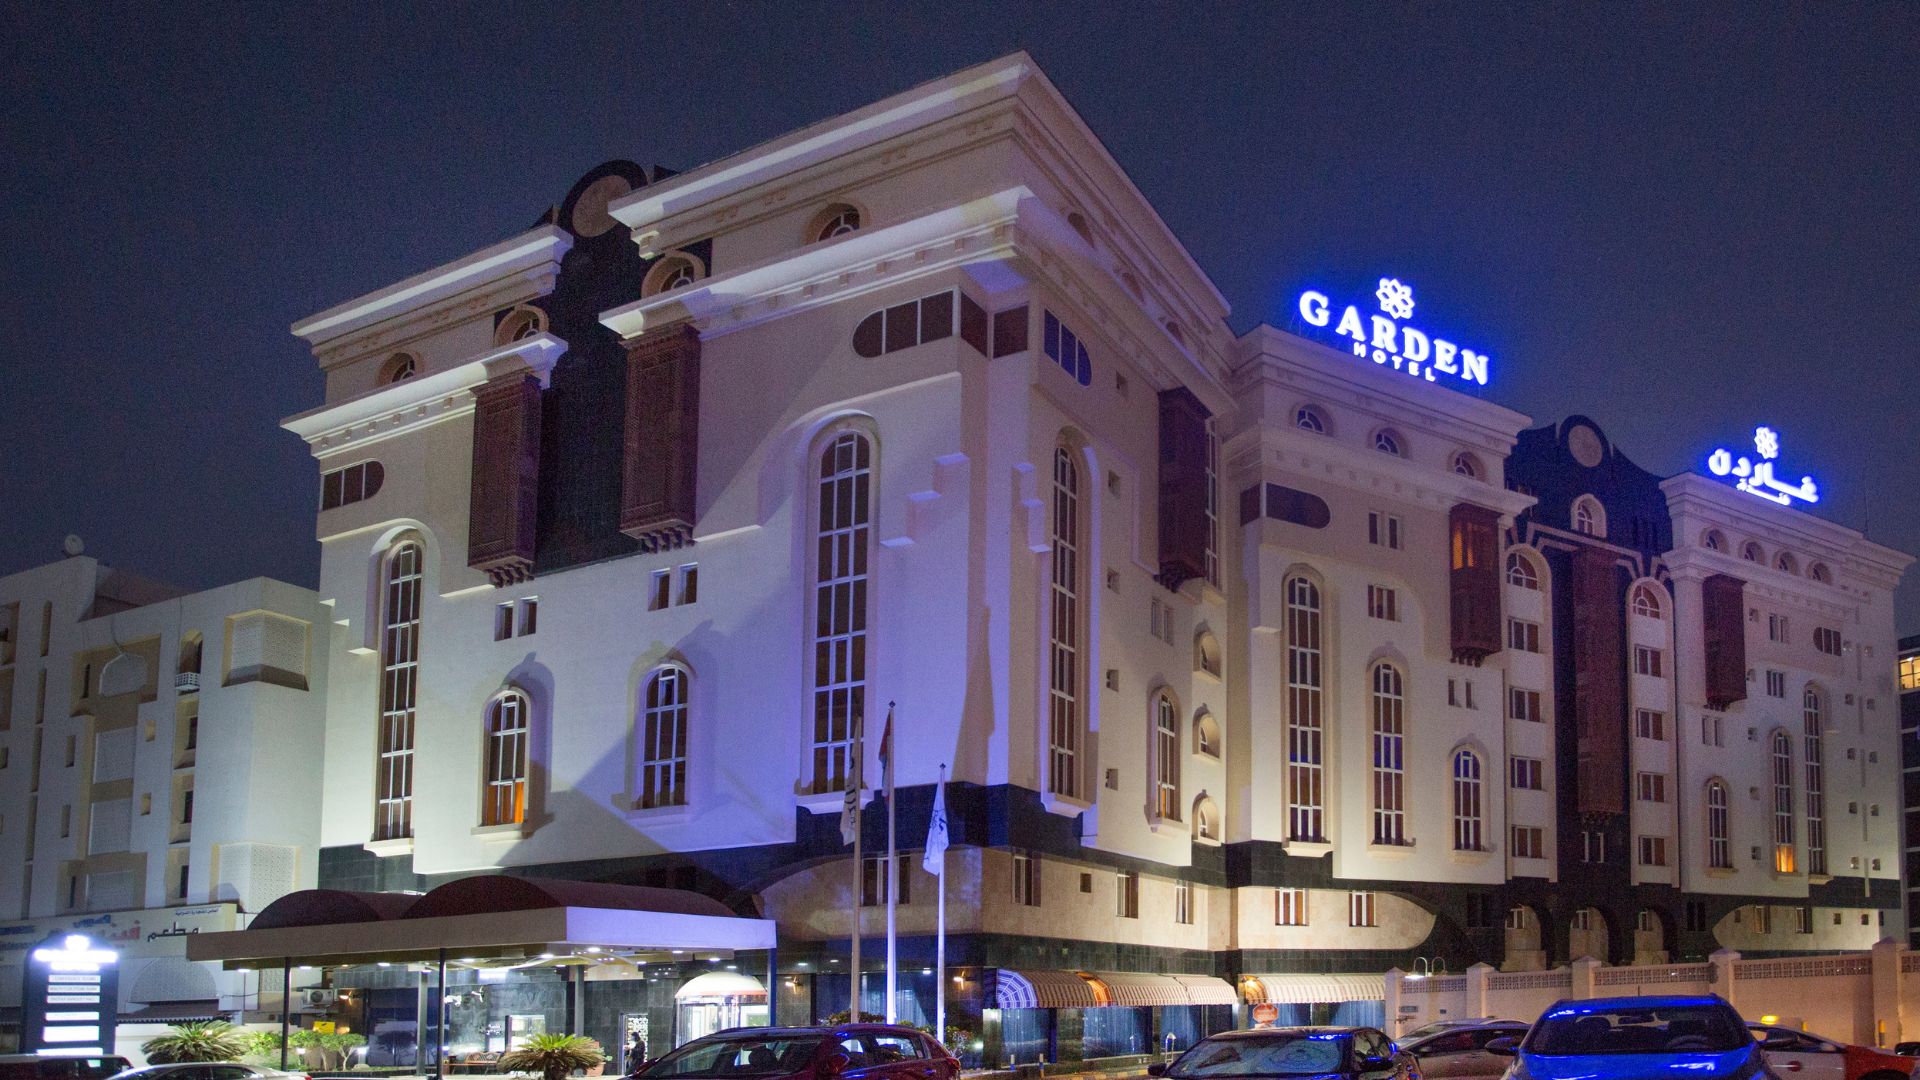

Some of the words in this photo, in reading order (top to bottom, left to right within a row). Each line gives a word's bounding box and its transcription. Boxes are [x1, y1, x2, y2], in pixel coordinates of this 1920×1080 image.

[1299, 290, 1489, 386] GARDEN
[1353, 341, 1436, 382] HOTEL
[147, 921, 200, 942] مطعم
